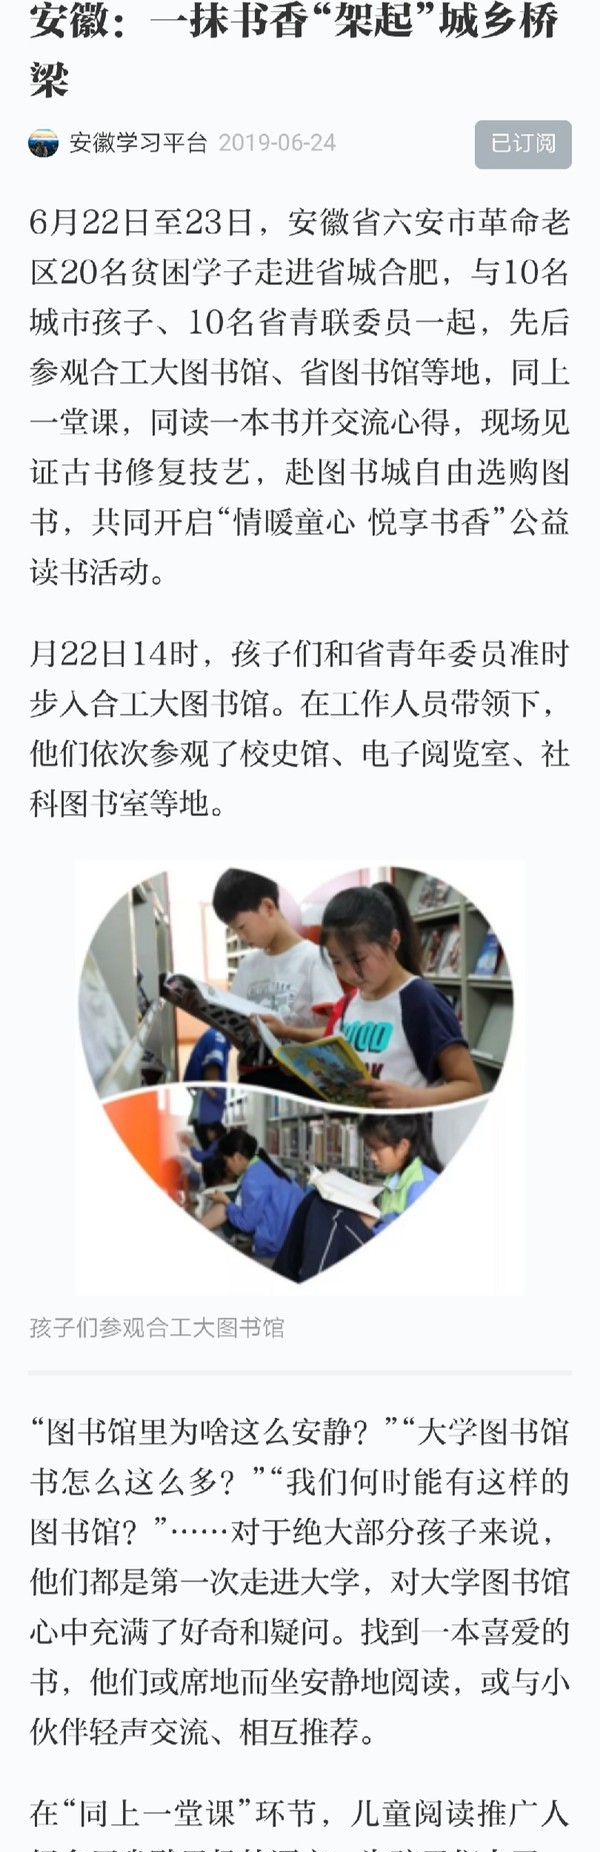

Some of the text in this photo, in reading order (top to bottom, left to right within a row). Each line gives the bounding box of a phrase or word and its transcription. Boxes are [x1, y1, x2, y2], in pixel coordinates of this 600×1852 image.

[30, 61, 68, 98] 梁
[70, 131, 336, 154] 安徽学习平台 2019-06-24
[492, 133, 555, 153] 已订阅
[30, 207, 570, 236] 6月22日至23日，安徽省六安市革命老
[32, 258, 567, 286] 区20名贫困学子走进省城合肥，与10名
[30, 307, 569, 336] 城市孩子、10名省青联委员一起，先后
[30, 358, 570, 386] 参观合工大图书馆、省图书馆等地，同上
[30, 407, 570, 436] 一堂课，同读一本书并交流心得，现场见
[30, 458, 569, 486] 证古书修复技艺，赴图书城自由选购图
[30, 507, 569, 536] 书，共同开启“情暖童心 悦享书香”公益
[30, 558, 161, 586] 读书活动。
[30, 639, 569, 667] 月22日14时，孩子们和省青年委员准时
[30, 689, 551, 718] 步入合工大图书馆。在工作人员带领下，
[30, 739, 570, 767] 他们依次参观了校史馆、电子阅览室、社
[30, 789, 221, 818] 科图书室等地。
[30, 1317, 284, 1338] 孩子们参观合工大图书馆
[30, 1567, 570, 1596] 他们都是第一次走进大学，对大学图书馆
[30, 1617, 569, 1646] 心中充满了好奇和疑问。找到一本喜爱的
[30, 1667, 570, 1696] 书，他们或席地而坐安静地阅读，或与小
[30, 1717, 371, 1746] 伙伴轻声交流、相互推荐。
